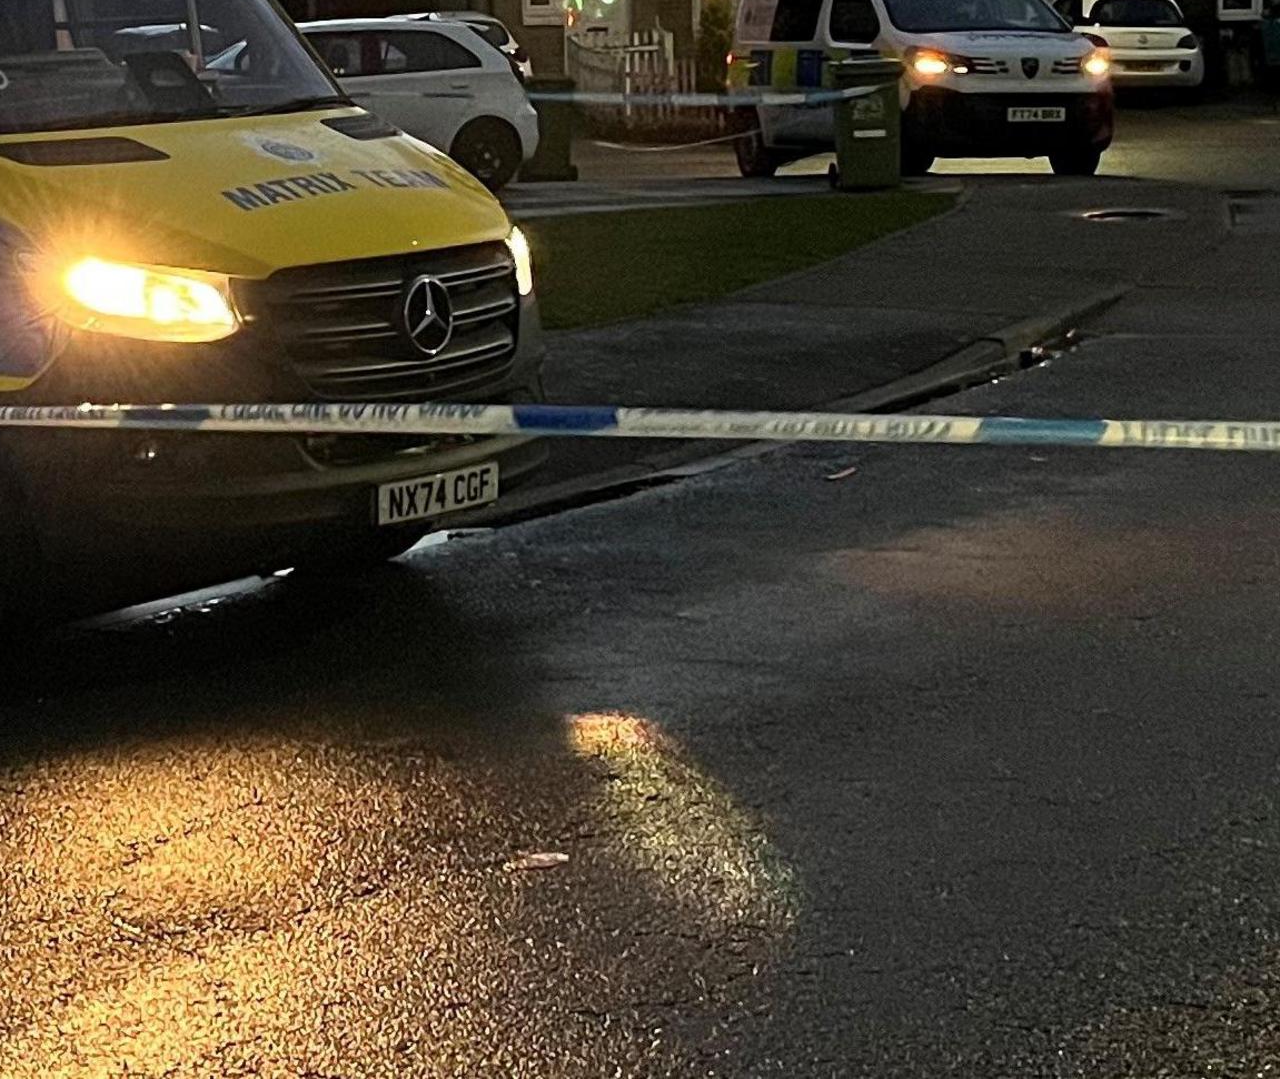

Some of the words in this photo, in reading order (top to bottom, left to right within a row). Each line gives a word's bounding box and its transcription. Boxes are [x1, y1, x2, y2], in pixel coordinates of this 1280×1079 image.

[221, 172, 357, 210] MATRIX
[350, 170, 451, 188] TEAM
[389, 479, 446, 519] NX74
[454, 468, 491, 504] CGF
